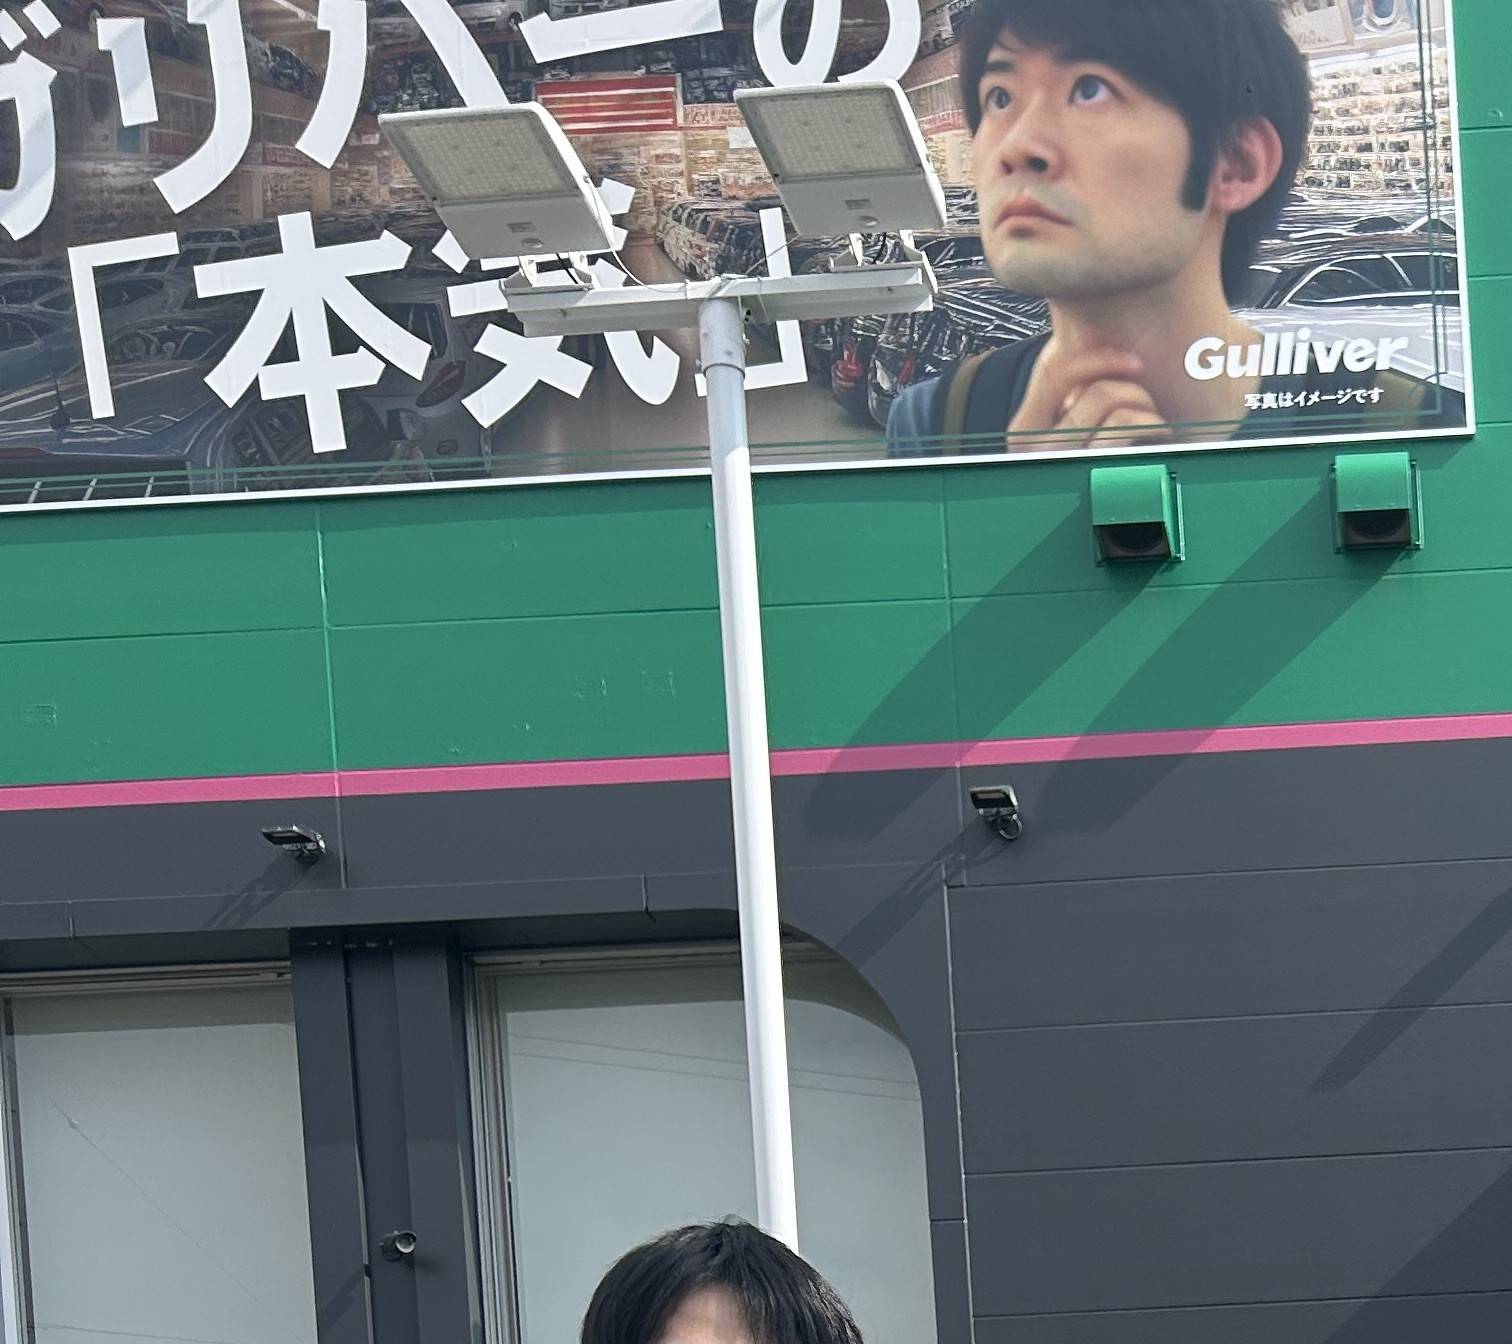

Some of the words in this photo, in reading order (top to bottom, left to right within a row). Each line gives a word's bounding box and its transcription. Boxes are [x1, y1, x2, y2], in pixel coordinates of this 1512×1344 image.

[1184, 327, 1408, 381] Gulliver
[1244, 387, 1384, 410] 写真はイメージです
